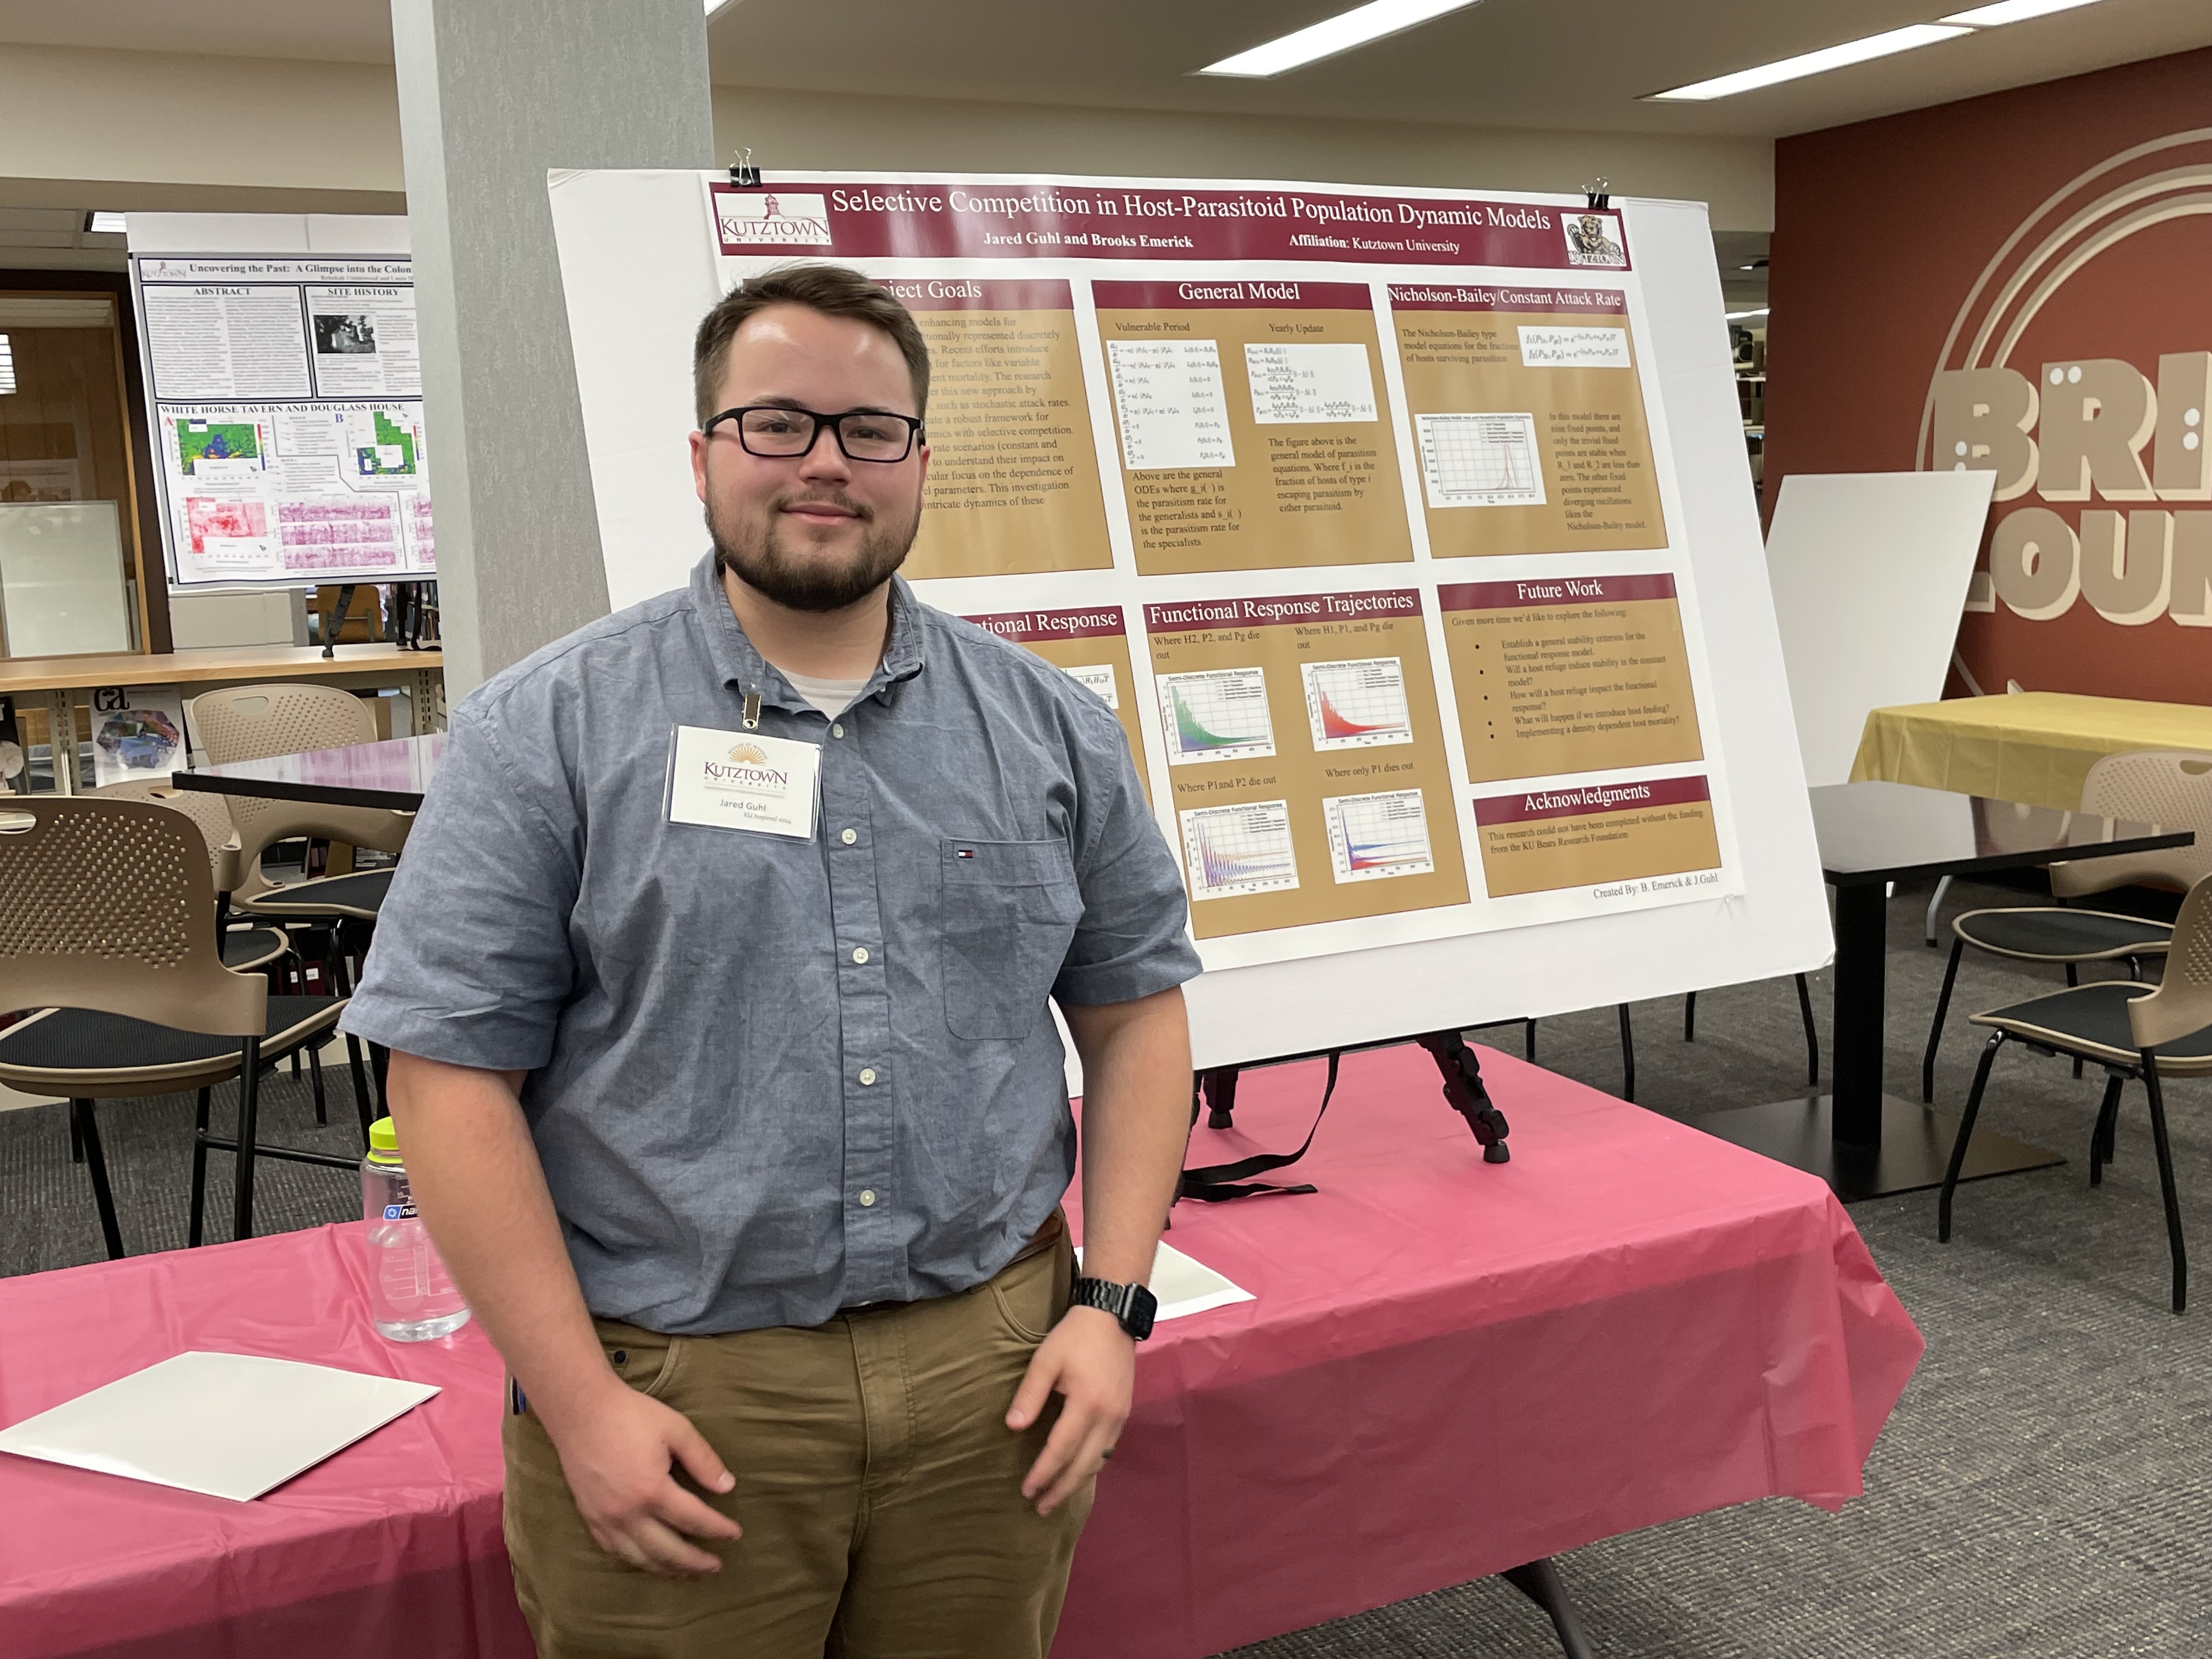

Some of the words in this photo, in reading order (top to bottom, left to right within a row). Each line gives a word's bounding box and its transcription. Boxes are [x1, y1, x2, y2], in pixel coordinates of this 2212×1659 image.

[831, 189, 942, 212] Selective
[949, 191, 1091, 219] Competition
[1096, 193, 1119, 215] in
[1121, 194, 1287, 217] Host-Parasitoid
[1291, 198, 1393, 225] Population
[1396, 203, 1482, 229] Dynamic
[1485, 206, 1550, 229] Models
[721, 218, 828, 236] KUTZTOWN
[983, 232, 1023, 245] Jared
[1025, 232, 1060, 244] Guhl
[1063, 233, 1088, 245] and
[1090, 233, 1137, 246] Brooks
[1138, 234, 1194, 247] Emerick
[1289, 234, 1350, 249] Affiliation:
[1351, 237, 1404, 250] Kutztown
[1404, 239, 1459, 255] University
[1567, 251, 1625, 264] KUTZTOWN
[189, 263, 246, 274] Uncovering
[248, 264, 263, 272] the
[266, 264, 290, 272] Past:
[305, 264, 344, 274] Glimpse
[927, 280, 982, 298] Goals
[1178, 283, 1244, 300] General
[1247, 283, 1300, 300] Model
[1387, 286, 1553, 306] Nicholson-Bailey/Constant
[1555, 291, 1593, 305] Attack
[1594, 292, 1621, 306] Rate
[1114, 321, 1161, 331] Vulnerable
[1163, 321, 1190, 331] Period
[1268, 323, 1294, 335] Yearly
[1295, 324, 1324, 335] Update
[1400, 328, 1416, 337] The
[1417, 329, 1480, 340] Nicholson-Bailey
[1481, 330, 1497, 340] type
[161, 405, 198, 414] WHITE
[201, 405, 237, 414] HORSE
[311, 403, 367, 412] DOUGLASS
[335, 413, 344, 423] B
[932, 443, 950, 452] rate
[952, 441, 995, 452] scenarios
[997, 441, 1039, 452] (constant
[1041, 438, 1058, 449] and
[1267, 438, 1284, 447] The
[1285, 437, 1309, 448] figure
[1311, 437, 1334, 445] above
[1344, 436, 1357, 444] the
[944, 454, 994, 466] understand
[996, 454, 1017, 464] their
[1019, 454, 1051, 465] impact
[1270, 450, 1299, 462] general
[1300, 449, 1325, 459] model
[1327, 449, 1336, 458] of
[1336, 449, 1377, 460] parasitism
[951, 470, 976, 480] focus
[993, 469, 1007, 478] the
[1009, 467, 1062, 480] dependence
[1064, 466, 1074, 475] of
[1132, 471, 1160, 481] Above
[1177, 470, 1190, 479] the
[1192, 469, 1223, 481] general
[933, 486, 986, 497] parameters.
[987, 483, 1009, 493] This
[1011, 480, 1069, 493] investigation
[1561, 487, 1582, 496] points
[1583, 484, 1622, 495] experienced
[1136, 499, 1149, 508] the
[1151, 499, 1195, 510] parasitism
[1214, 495, 1226, 505] for
[1150, 525, 1163, 534] the
[1165, 525, 1208, 536] parasitism
[1210, 523, 1226, 532] rate
[1228, 522, 1240, 531] for
[1142, 539, 1156, 549] the
[1158, 537, 1201, 550] specialists
[1516, 583, 1562, 600] Future
[1564, 579, 1603, 596] Work
[1149, 601, 1239, 624] Functional
[1244, 600, 1320, 621] Response
[1322, 591, 1414, 616] Trajectories
[1036, 613, 1118, 634] Response
[1452, 617, 1475, 627] Given
[1512, 613, 1531, 622] we'd
[1531, 612, 1545, 622] like
[1555, 611, 1581, 622] explore
[1581, 610, 1593, 618] the
[1594, 608, 1627, 618] following:
[1294, 626, 1321, 635] Where
[1322, 625, 1338, 634] H1,
[1338, 624, 1352, 633] P1,
[1353, 623, 1368, 632] and
[1368, 622, 1380, 633] Pg
[1382, 621, 1393, 630] die
[1153, 636, 1182, 645] Where
[1183, 634, 1200, 644] H2,
[1201, 633, 1216, 642] P2,
[1217, 631, 1233, 641] and
[1233, 631, 1245, 642] Pg
[1247, 630, 1260, 639] die
[1296, 641, 1310, 649] out
[1155, 651, 1170, 659] out
[704, 761, 788, 785] KUTZTOWN
[1324, 768, 1351, 777] Where
[1352, 765, 1369, 776] only
[1370, 764, 1381, 774] P1
[1383, 763, 1400, 772] dies
[1401, 761, 1414, 770] out
[1177, 783, 1205, 793] Where
[1207, 778, 1234, 790] P1and
[1235, 777, 1246, 787] P2
[1248, 776, 1261, 786] die
[1262, 775, 1277, 784] out
[720, 799, 743, 809] Jared
[746, 802, 766, 811] Guhl
[1524, 785, 1650, 811] Acknowledgments
[1593, 885, 1624, 899] Created
[1640, 882, 1650, 892] B.
[1651, 877, 1683, 890] Emerick
[1685, 877, 1692, 885] &
